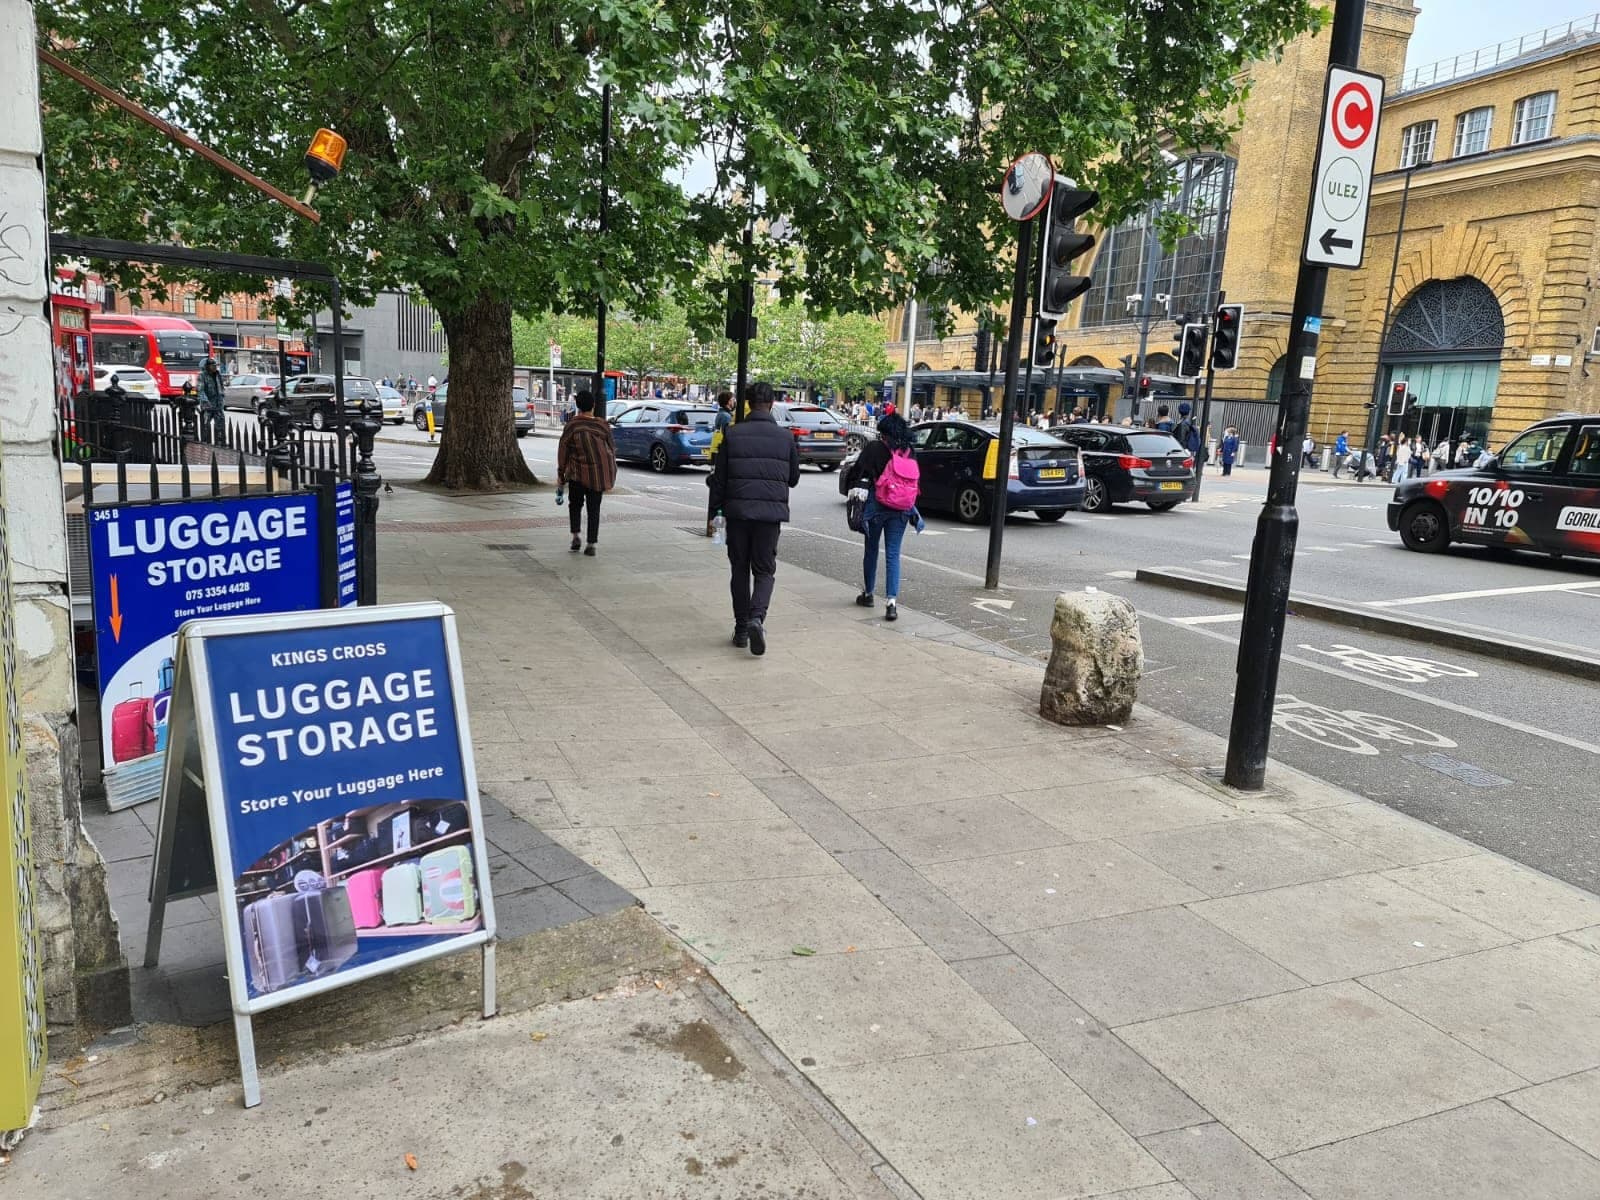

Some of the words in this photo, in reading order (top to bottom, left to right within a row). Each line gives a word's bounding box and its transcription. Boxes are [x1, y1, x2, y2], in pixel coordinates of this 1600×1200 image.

[1328, 181, 1358, 199] ULEZ
[1468, 487, 1524, 508] 10/10
[94, 511, 110, 521] 345
[112, 509, 119, 519] B
[1463, 507, 1488, 525] IN
[1494, 509, 1519, 528] 10
[107, 506, 307, 557] LUGGAGE
[147, 548, 281, 586] STORAGE
[185, 588, 203, 601] 075
[205, 586, 227, 598] 3354
[229, 582, 250, 595] 4428
[174, 606, 195, 618] Store
[197, 603, 213, 615] Your
[214, 600, 244, 612] Luggage
[244, 596, 261, 607] Here
[271, 649, 328, 667] KINGS
[333, 643, 387, 660] CROSS
[229, 668, 435, 724] LUGGAGE
[237, 708, 438, 767] STORAGE
[240, 794, 288, 814] Store
[292, 786, 333, 803] Your
[337, 773, 404, 795] Luggage
[408, 766, 444, 782] Here
